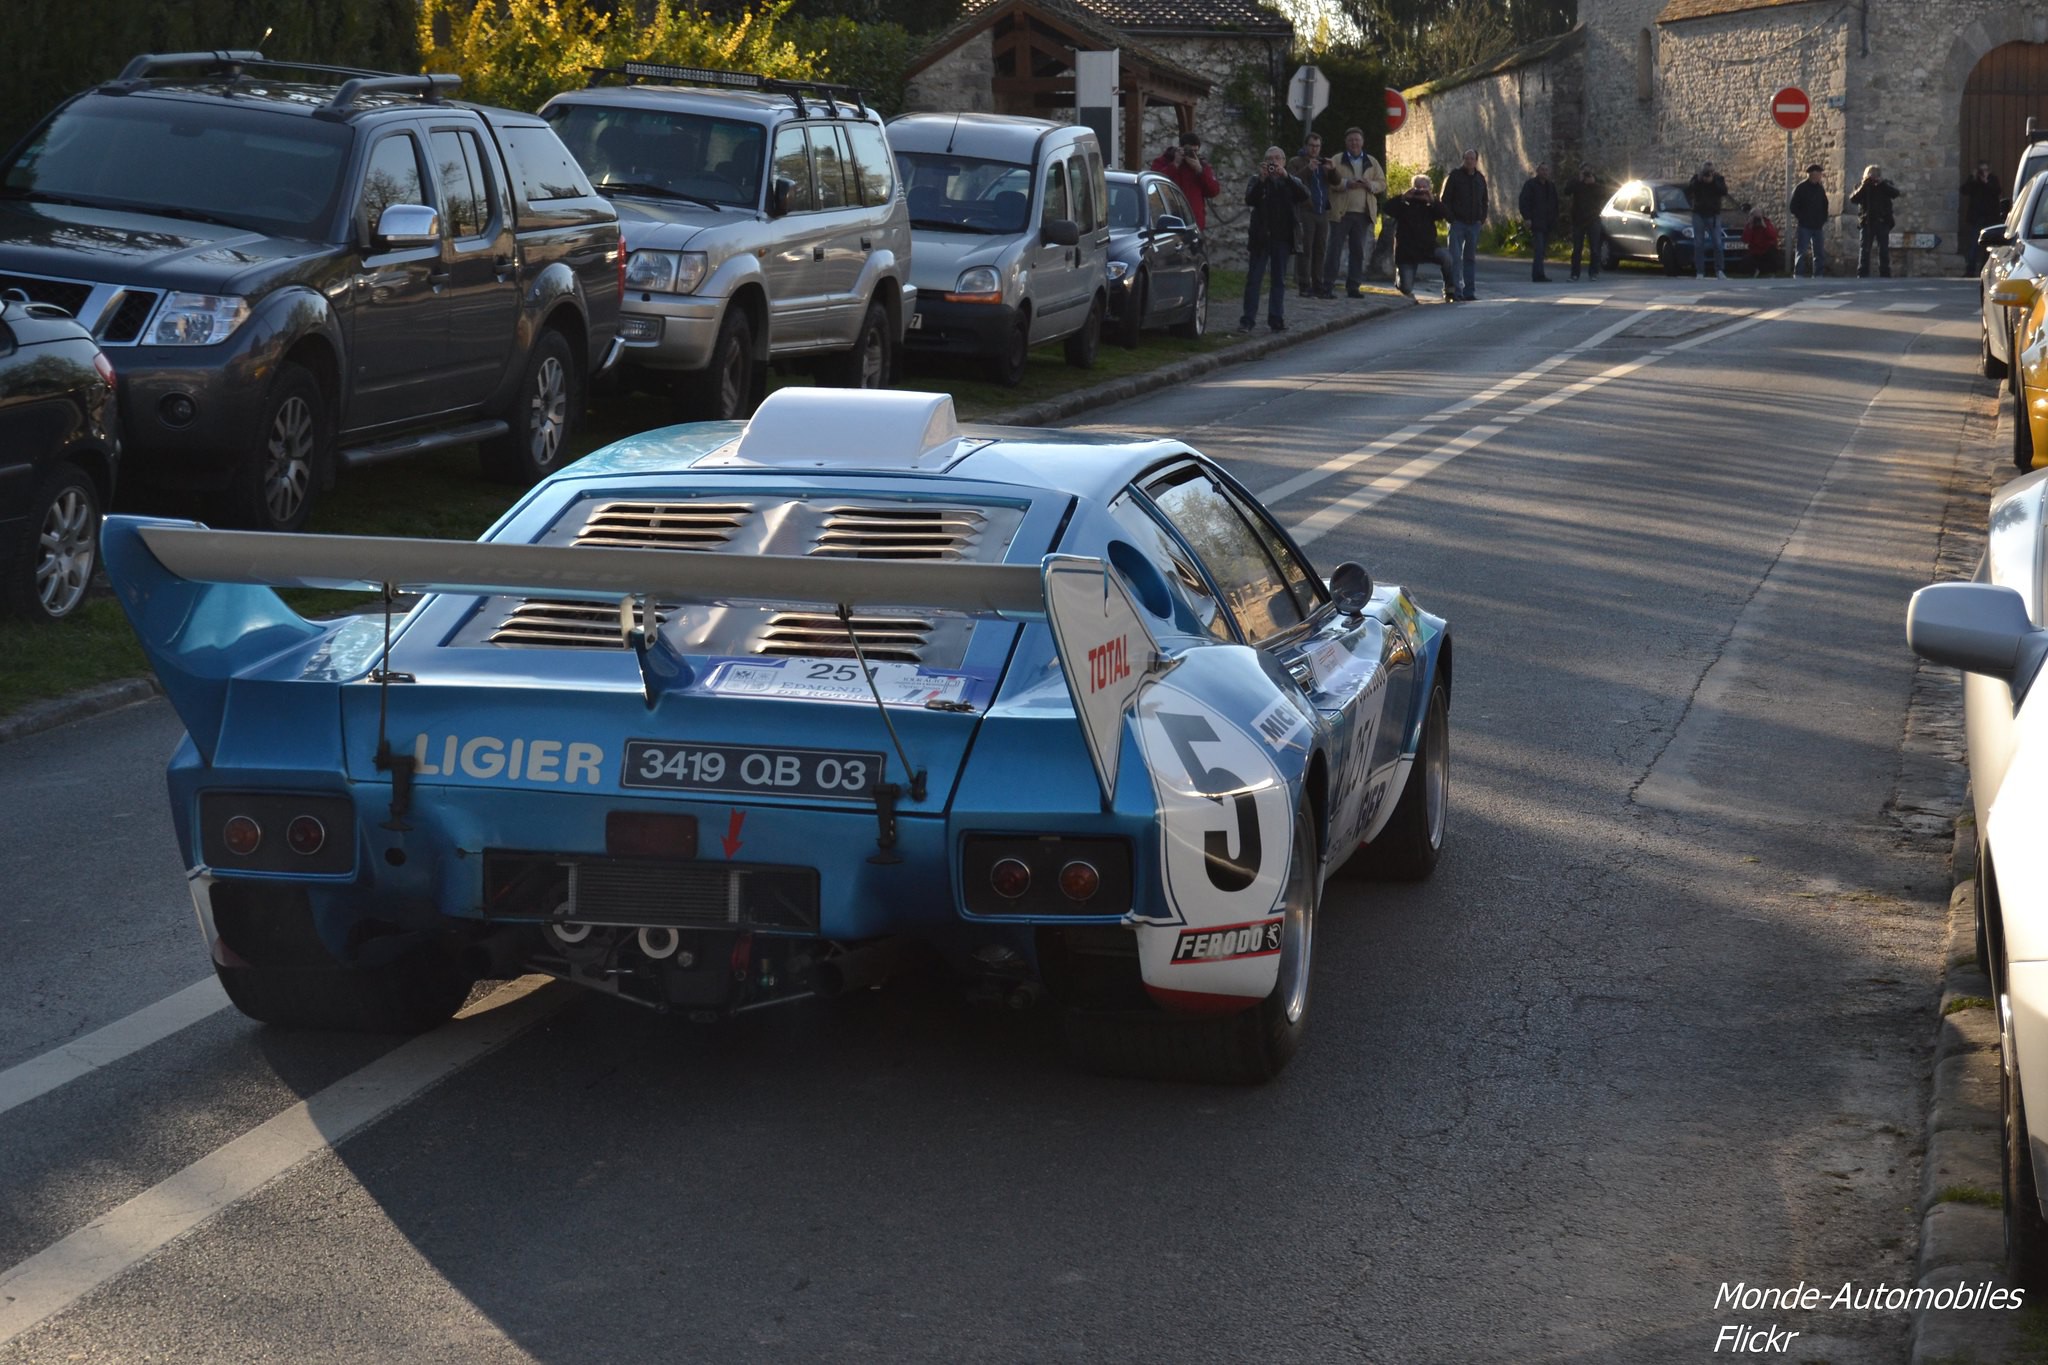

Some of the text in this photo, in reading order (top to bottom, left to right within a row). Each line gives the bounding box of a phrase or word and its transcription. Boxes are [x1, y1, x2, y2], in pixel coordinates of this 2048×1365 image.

[806, 662, 879, 682] 251
[1087, 633, 1131, 695] TOTAL
[780, 681, 863, 693] EDMOND
[414, 733, 605, 785] LIGIER
[640, 749, 867, 790] 3419 QB 03
[1156, 711, 1263, 893] 5
[1176, 926, 1264, 958] FERODO
